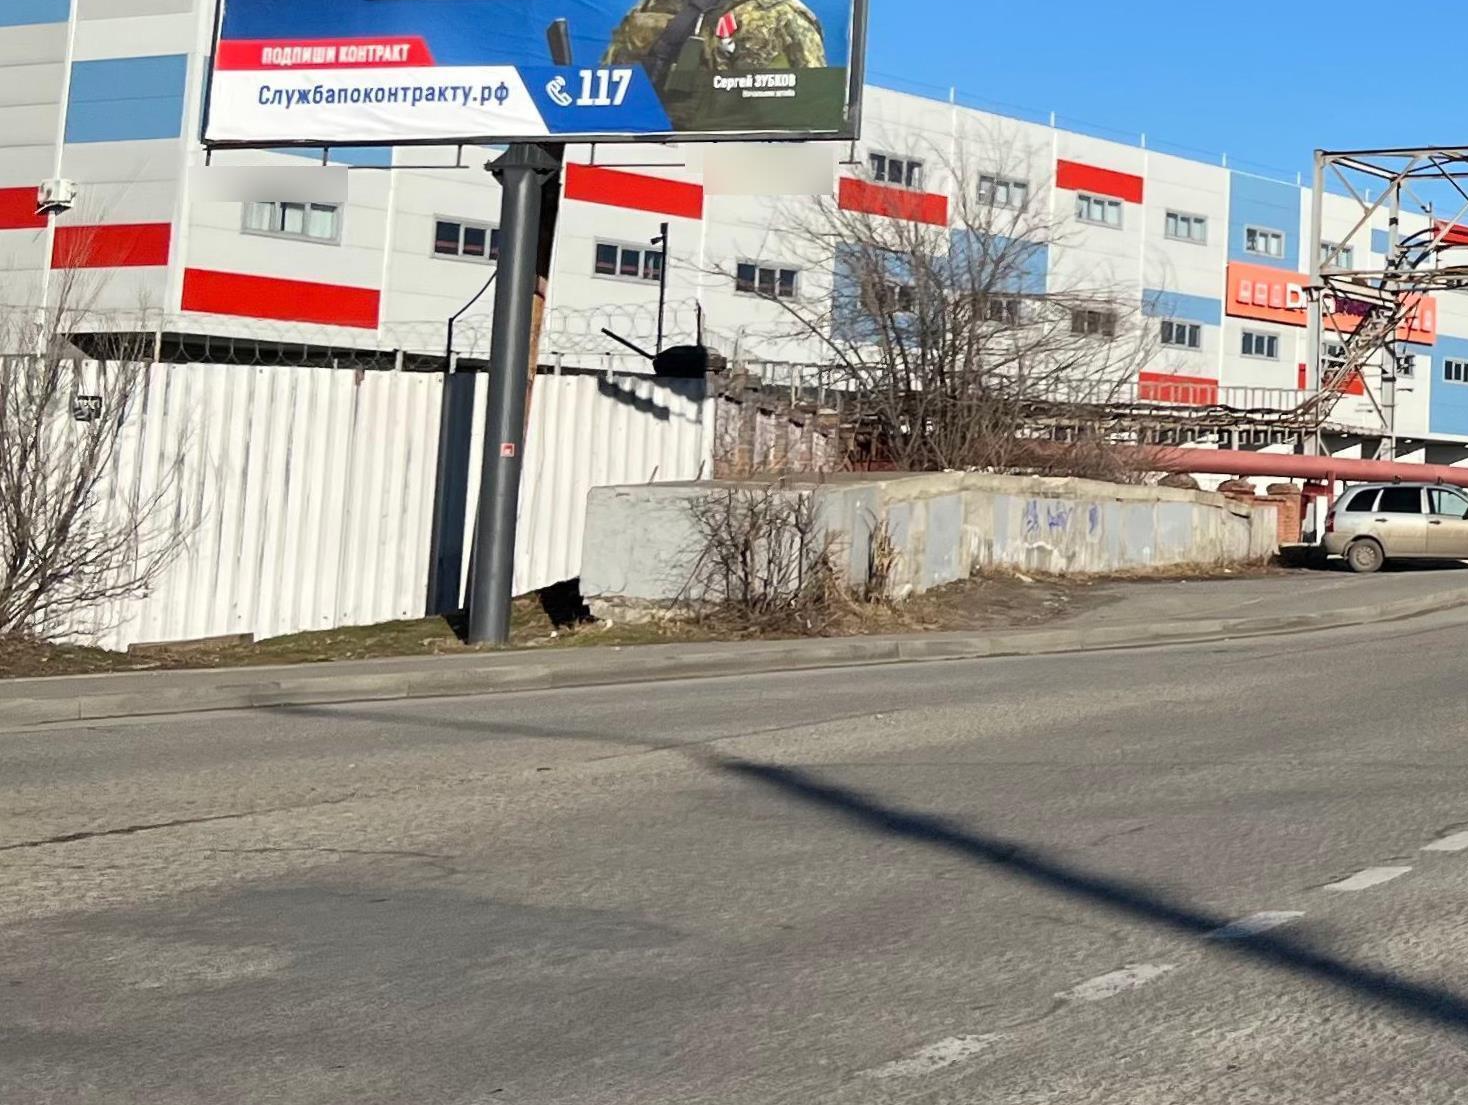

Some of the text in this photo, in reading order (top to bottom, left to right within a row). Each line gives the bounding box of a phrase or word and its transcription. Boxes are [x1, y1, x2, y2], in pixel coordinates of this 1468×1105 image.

[261, 44, 410, 67] ПОДПИШИ КОНТРАКТ
[576, 69, 633, 107] 117
[713, 73, 796, 91] Сергей ЗУБКОВ
[258, 82, 509, 110] Службапоконтракту.рф
